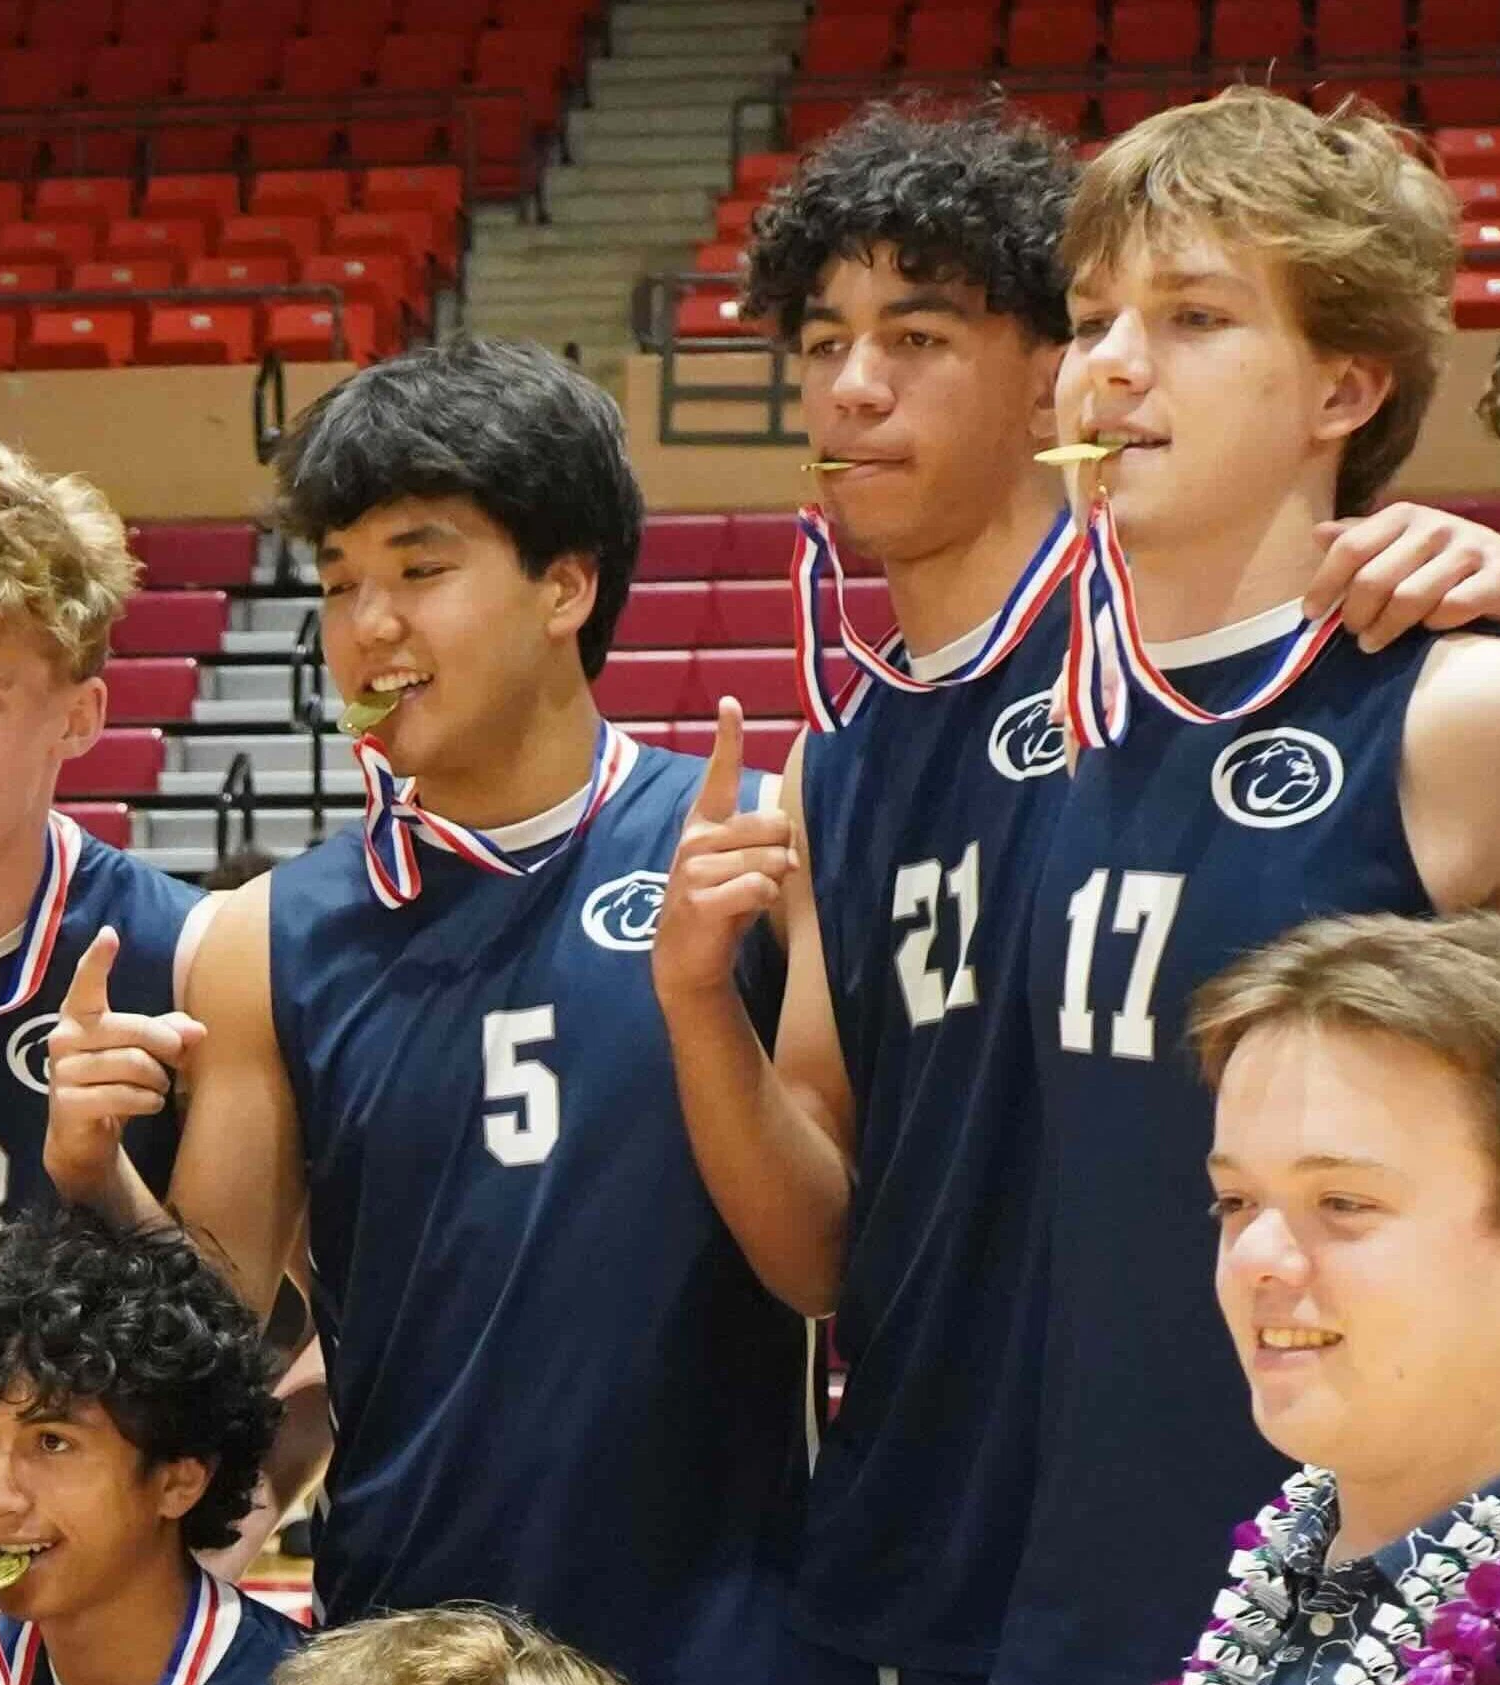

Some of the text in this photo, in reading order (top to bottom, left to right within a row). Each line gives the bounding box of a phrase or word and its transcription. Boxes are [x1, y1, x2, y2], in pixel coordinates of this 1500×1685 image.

[892, 841, 981, 1029] 21
[1057, 868, 1187, 1062] 17
[481, 1004, 560, 1168] 5
